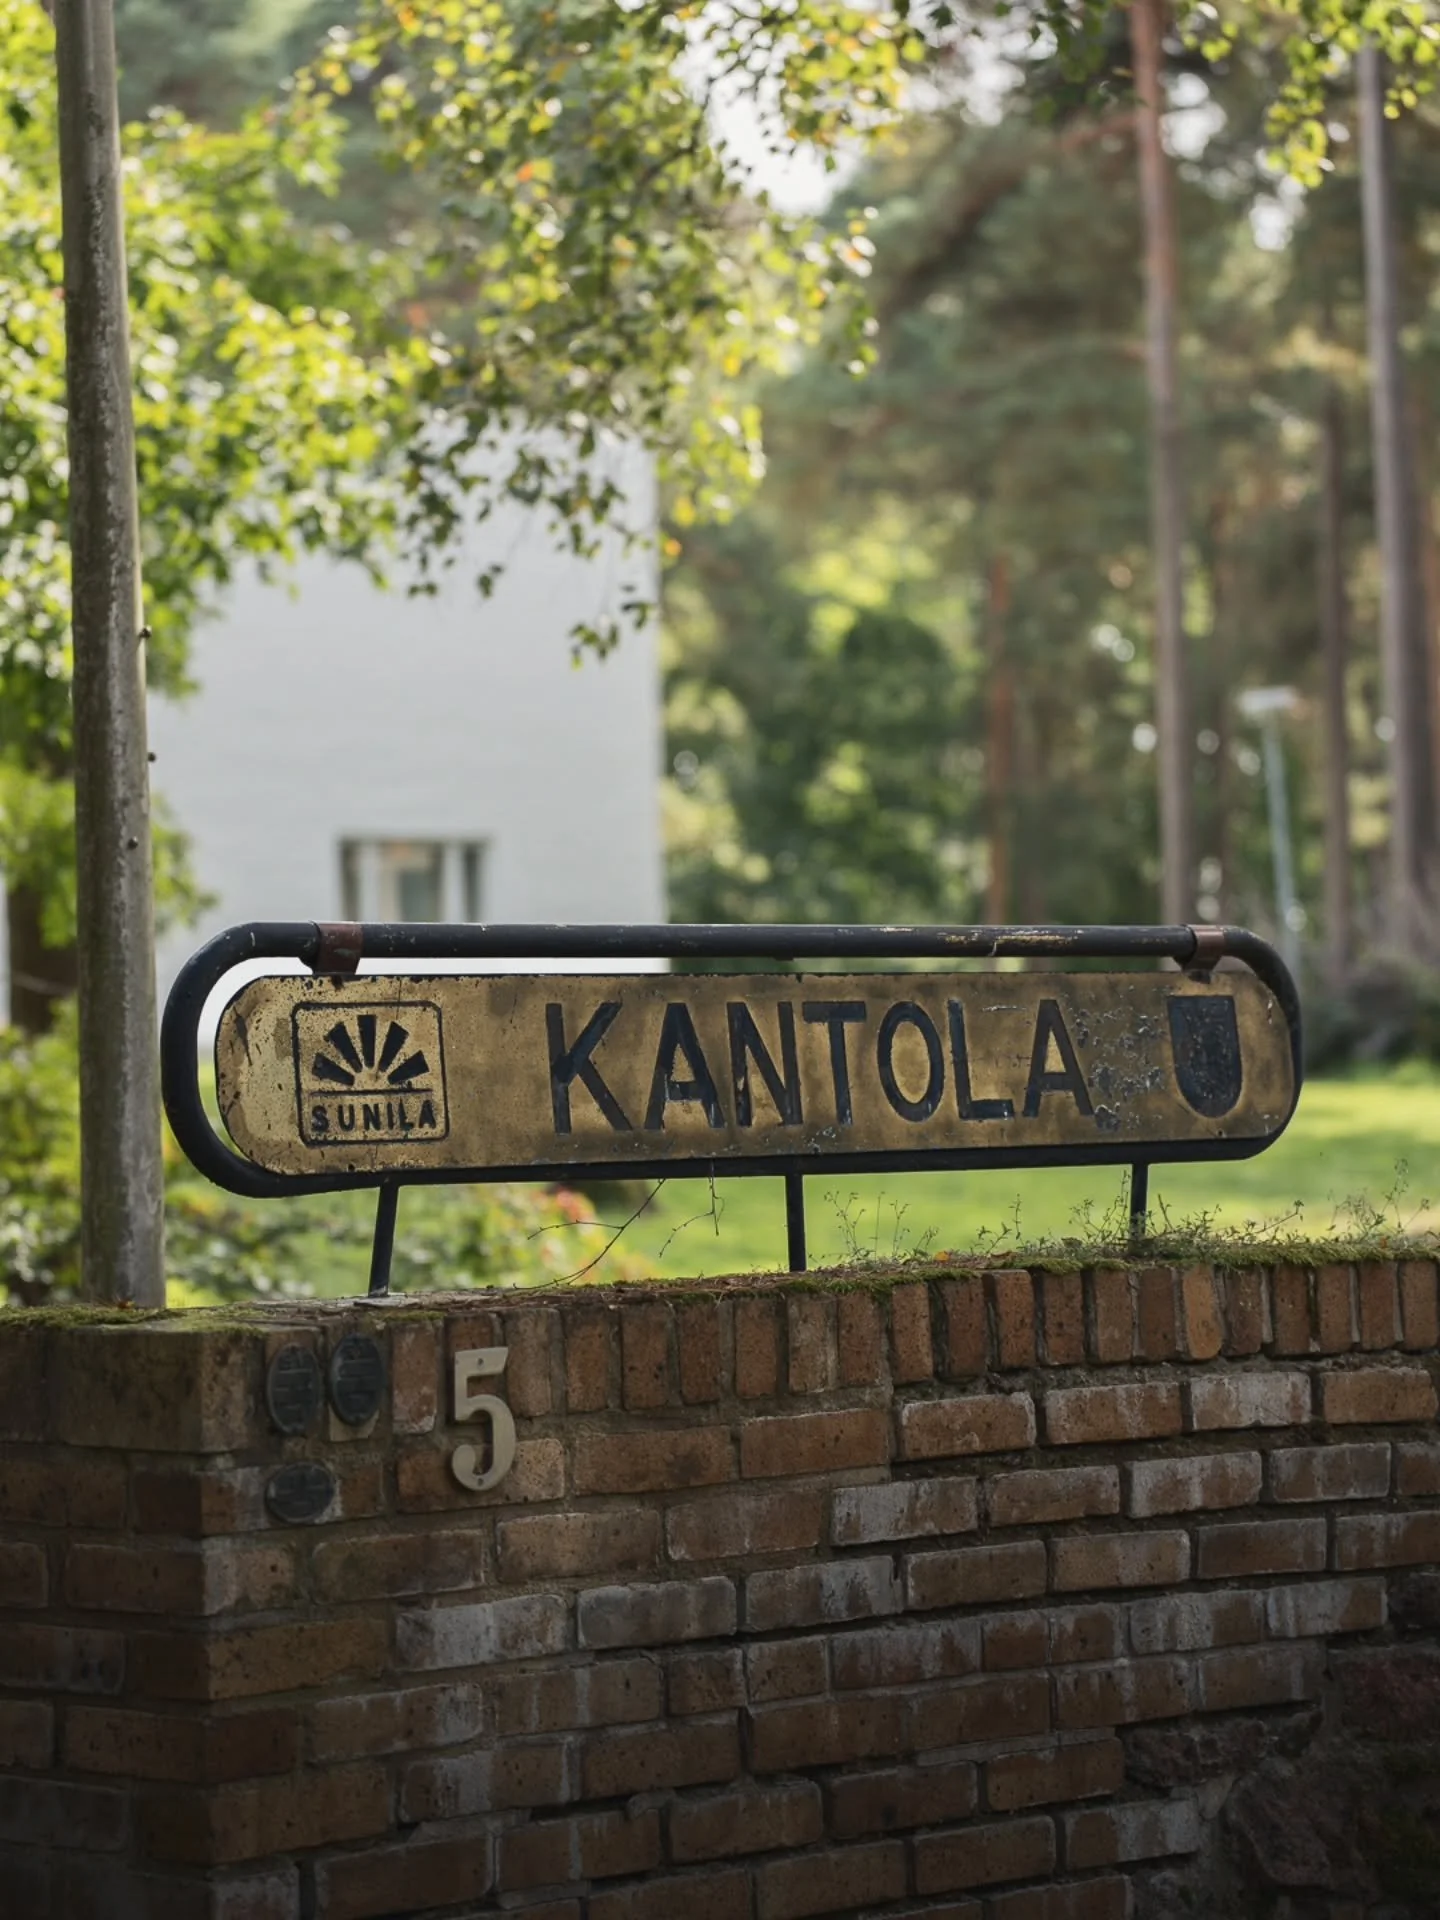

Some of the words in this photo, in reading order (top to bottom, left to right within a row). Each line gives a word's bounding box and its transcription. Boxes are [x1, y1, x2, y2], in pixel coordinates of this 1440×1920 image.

[310, 1099, 437, 1132] SUNILA
[545, 998, 1096, 1135] KANTOLA
[452, 1347, 516, 1491] 5
